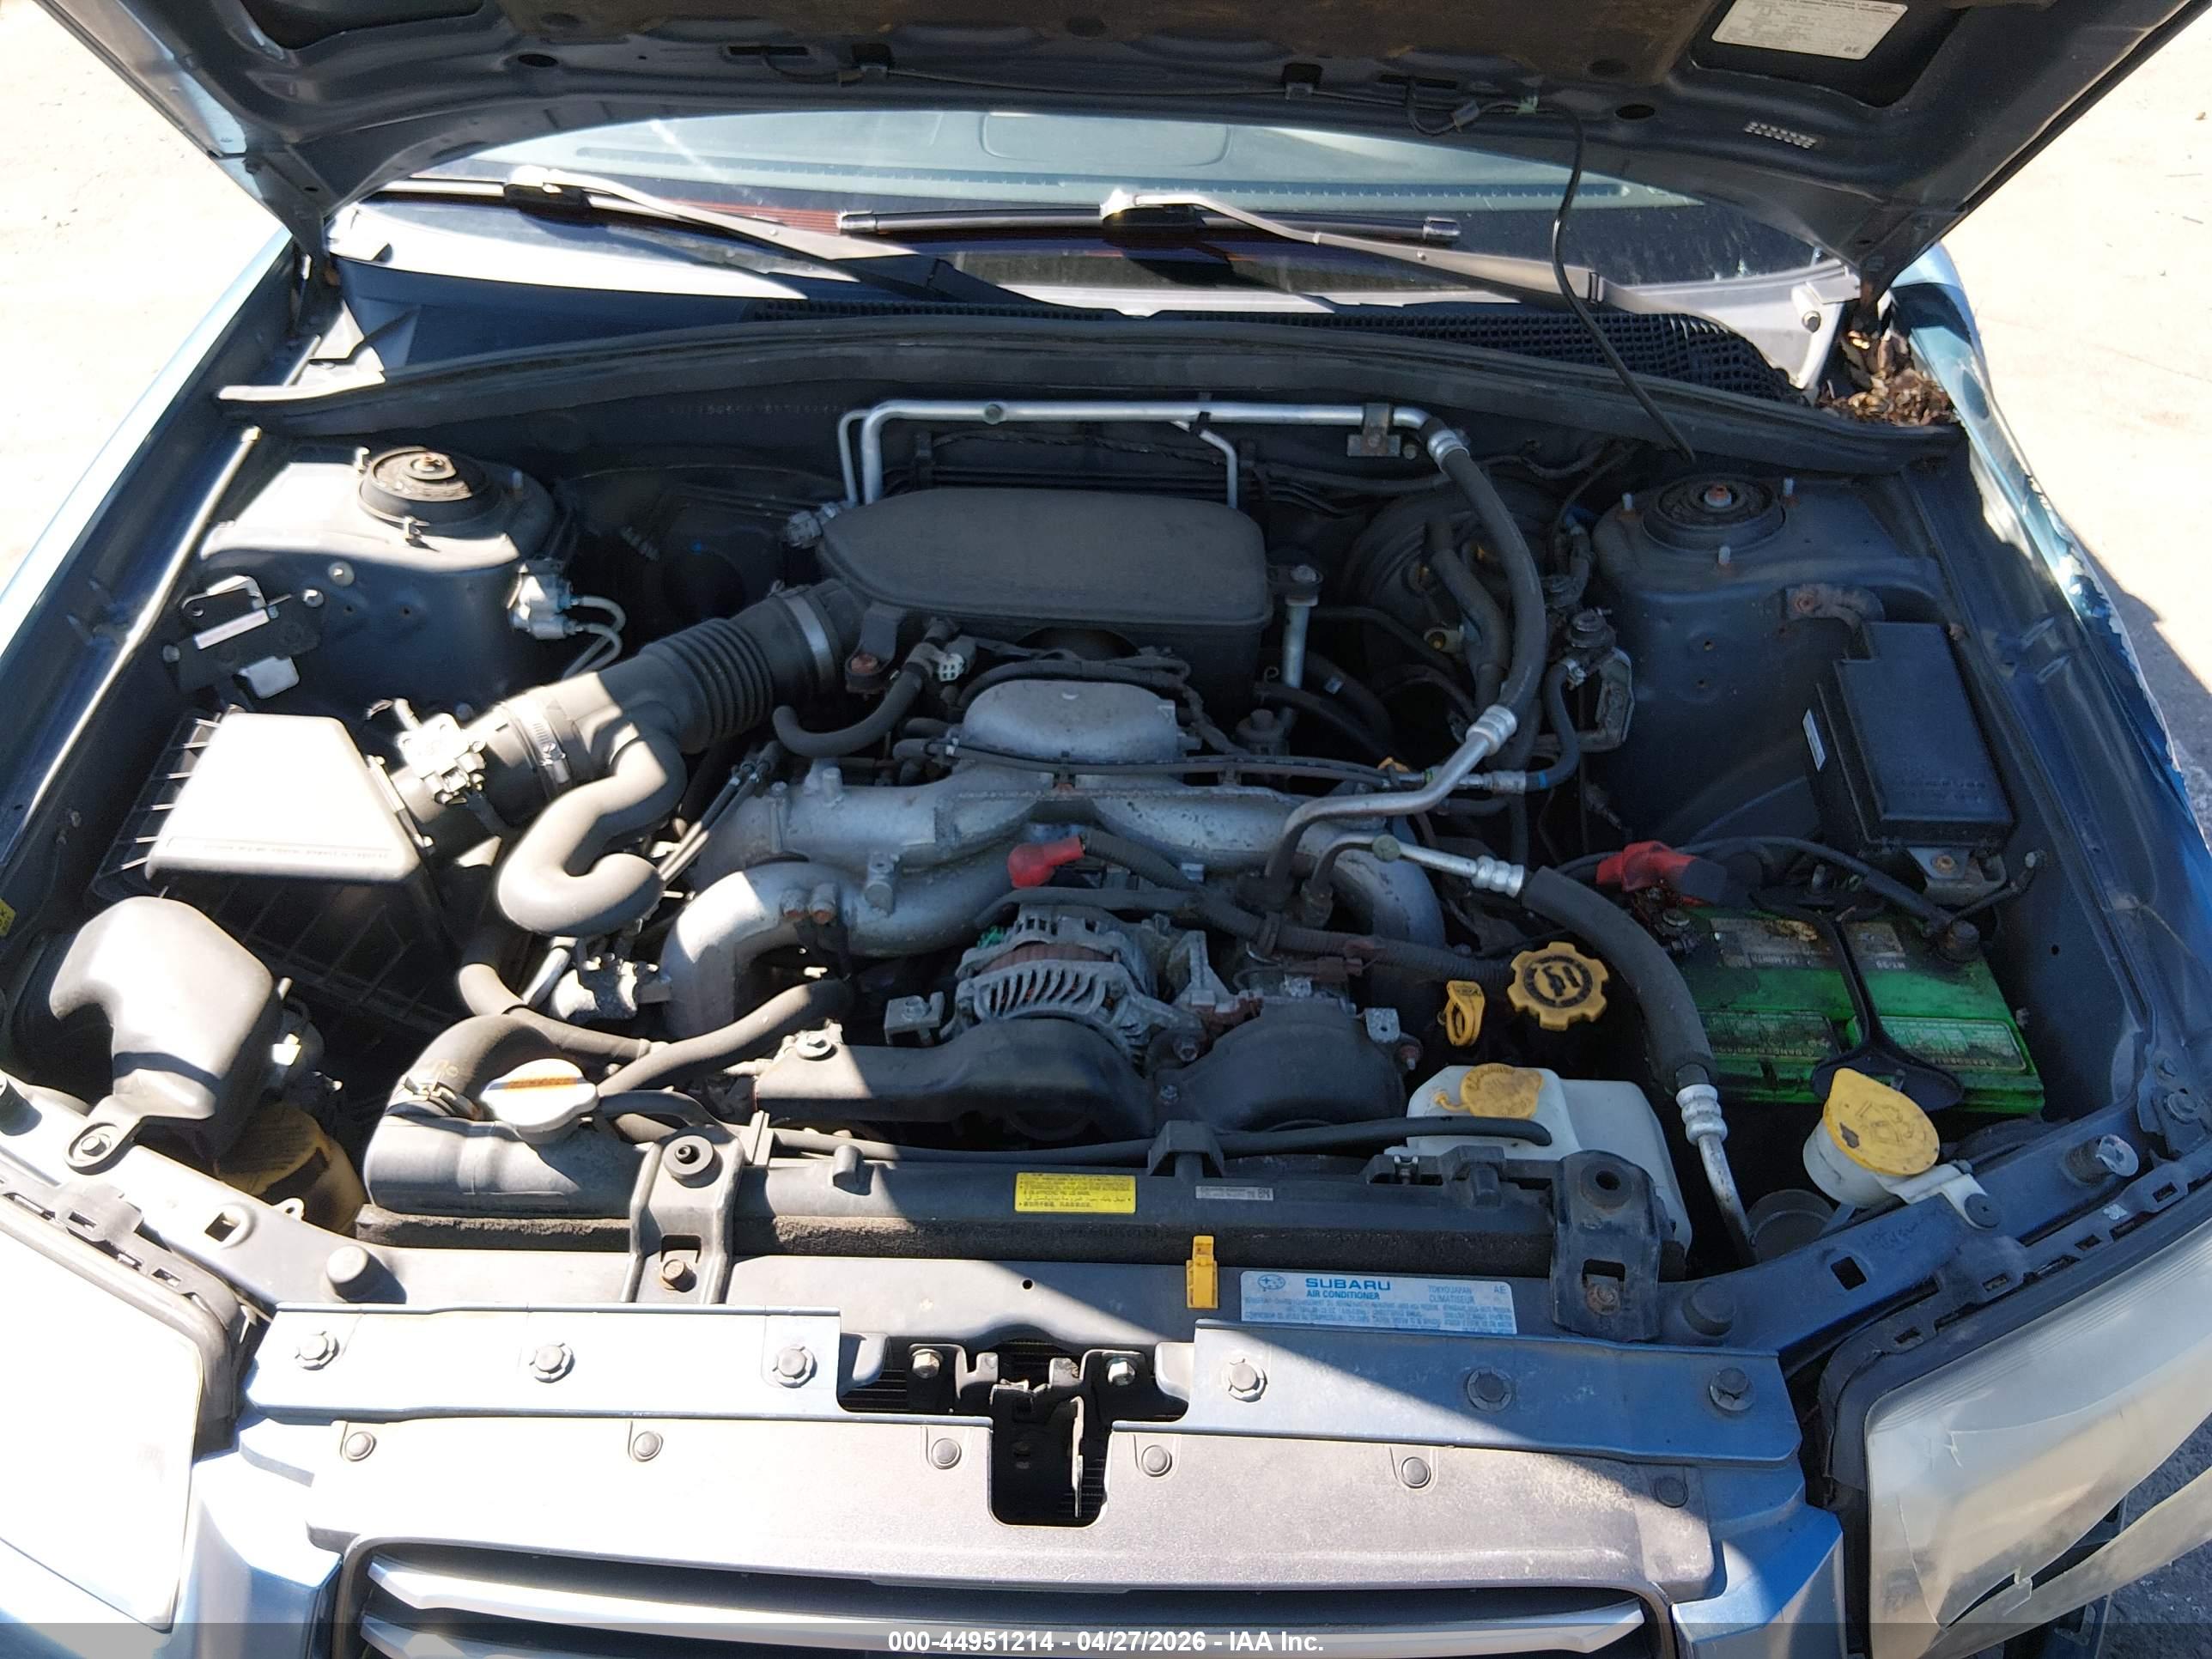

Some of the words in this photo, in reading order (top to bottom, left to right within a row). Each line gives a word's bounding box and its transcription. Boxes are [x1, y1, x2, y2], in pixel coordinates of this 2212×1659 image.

[1305, 1278, 1391, 1291] SUBARU
[1307, 1290, 1321, 1298] AIR
[1322, 1291, 1380, 1300] CONDITIONER
